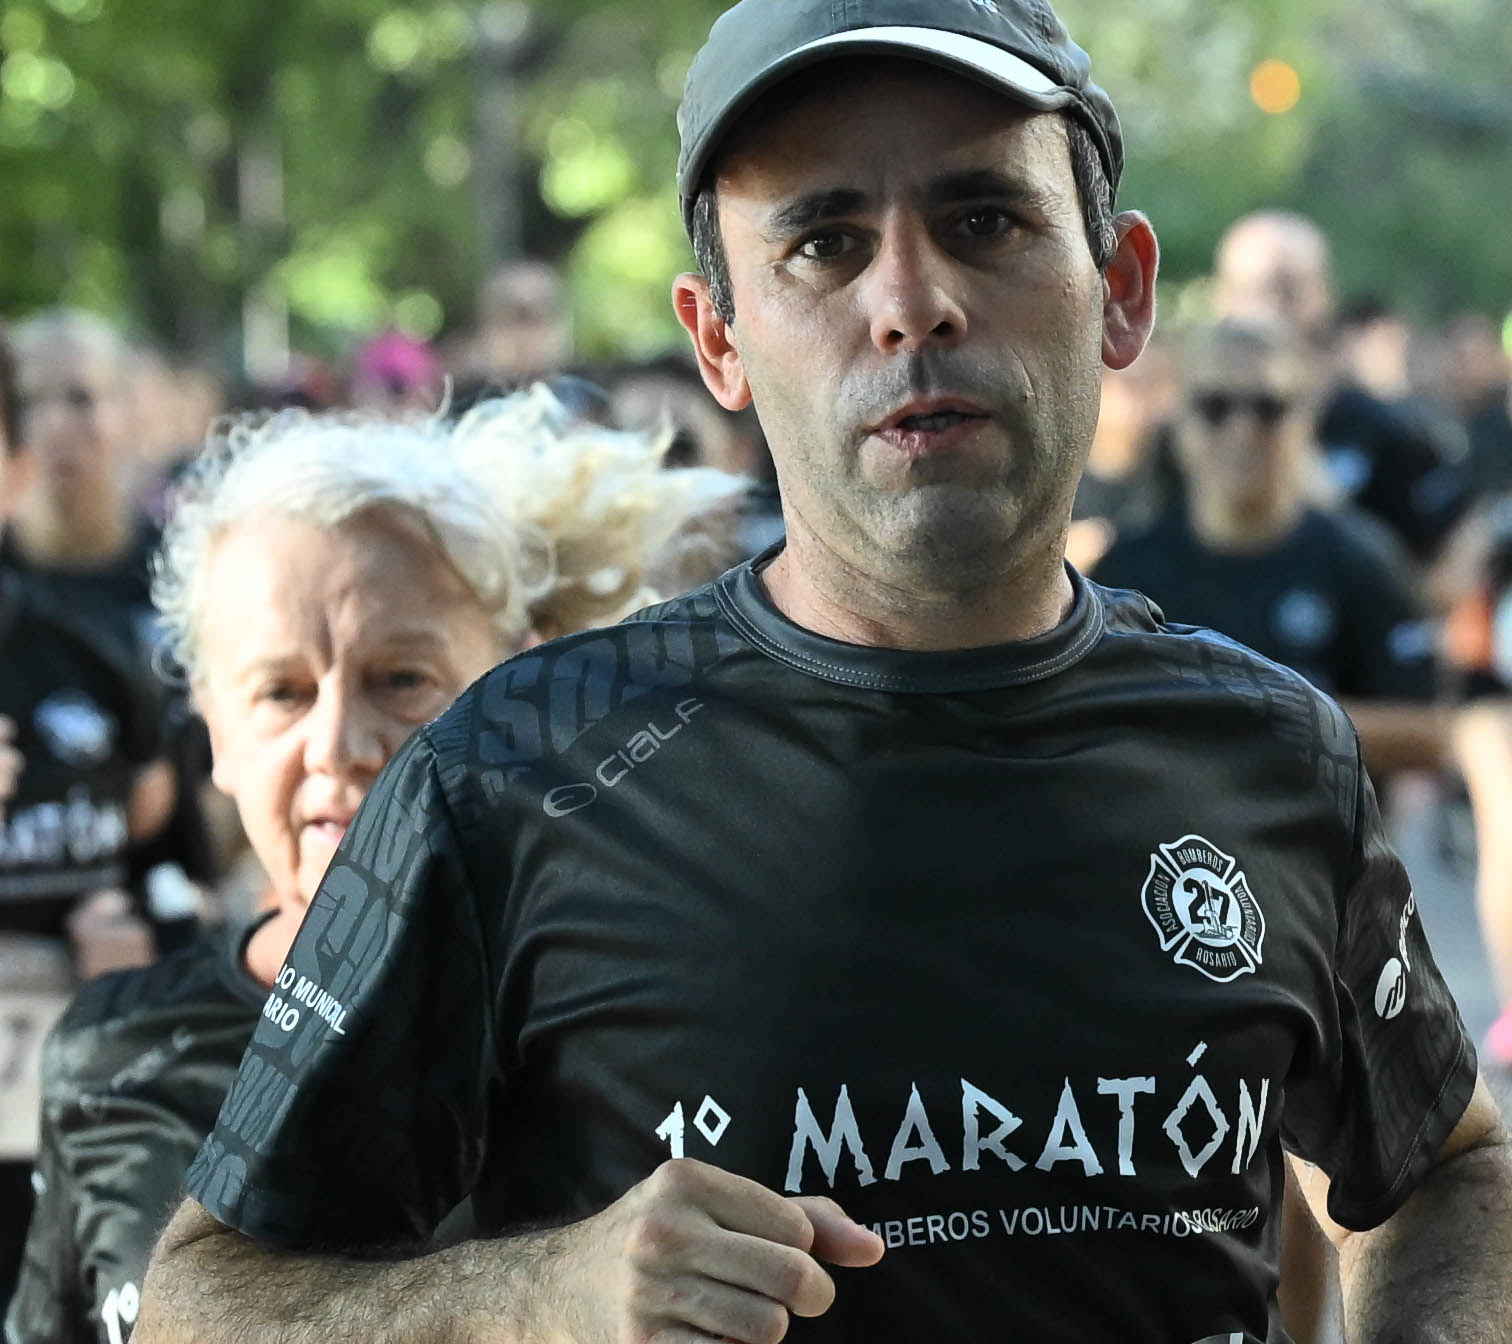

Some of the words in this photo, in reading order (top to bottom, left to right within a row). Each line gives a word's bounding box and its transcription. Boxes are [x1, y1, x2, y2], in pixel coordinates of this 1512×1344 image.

[1176, 847, 1224, 873] BOMBEROS
[1183, 878, 1231, 925] 27
[1195, 947, 1238, 969] ROSARIO
[784, 1041, 1270, 1193] MARATÓN
[999, 1205, 1202, 1238] VOLUNTARIOS
